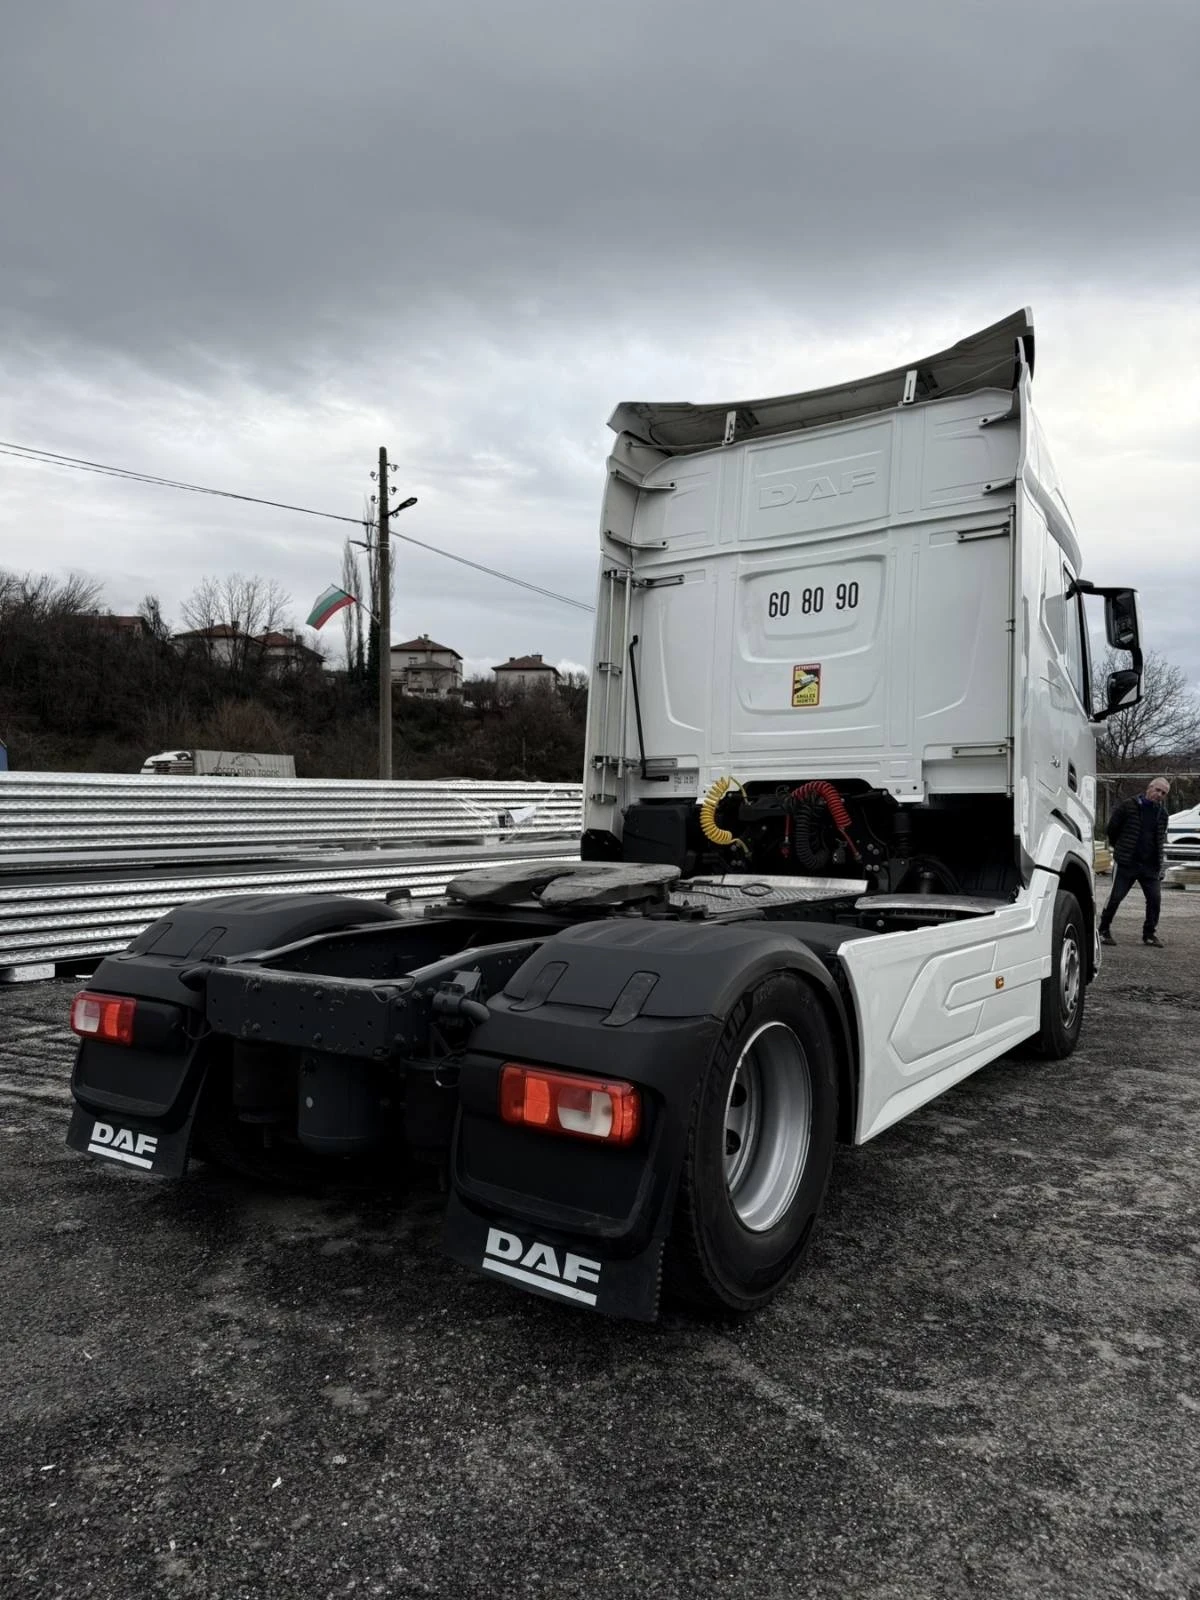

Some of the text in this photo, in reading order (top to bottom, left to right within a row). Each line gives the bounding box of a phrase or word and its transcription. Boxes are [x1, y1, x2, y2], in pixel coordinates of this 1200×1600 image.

[759, 467, 877, 510] DAF
[769, 581, 859, 618] 60 80 90
[91, 1121, 158, 1155] DAF
[485, 1227, 601, 1283] DAF
